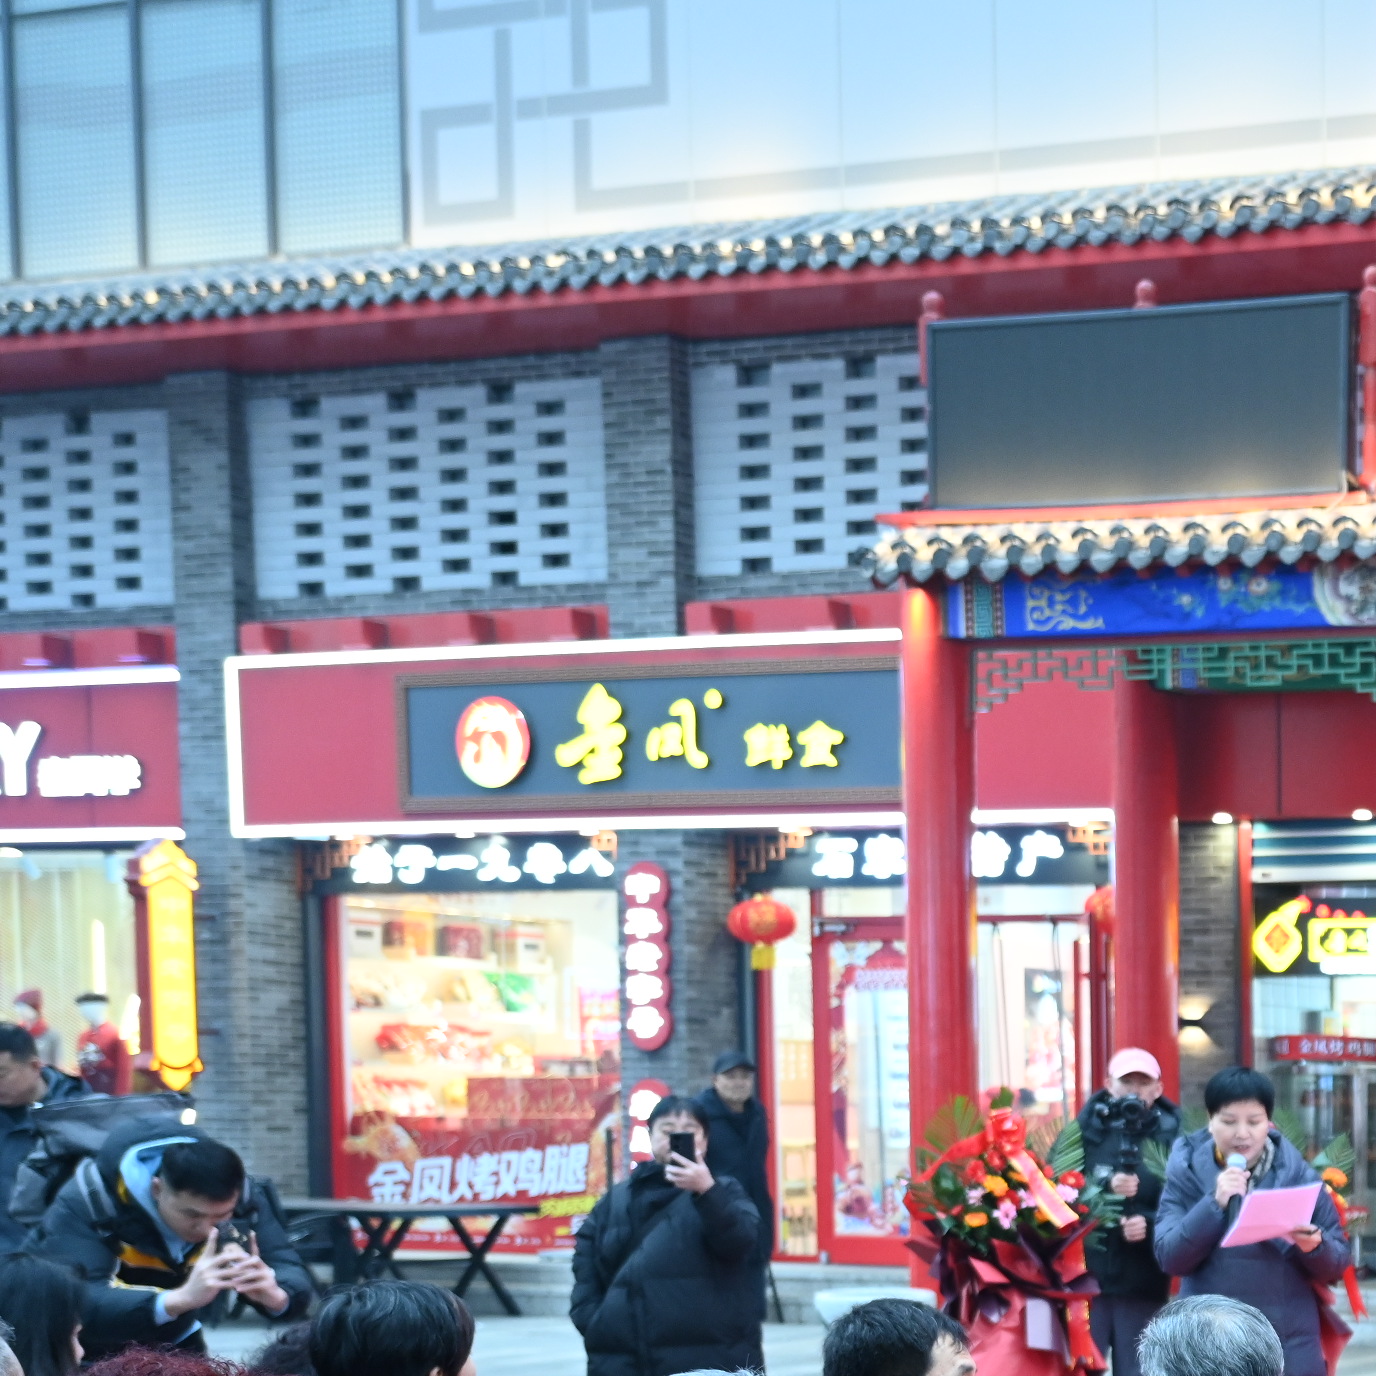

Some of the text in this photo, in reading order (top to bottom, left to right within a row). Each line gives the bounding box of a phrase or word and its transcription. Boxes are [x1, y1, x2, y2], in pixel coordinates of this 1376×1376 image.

[367, 1142, 590, 1205] 金凤烤鸡腿
